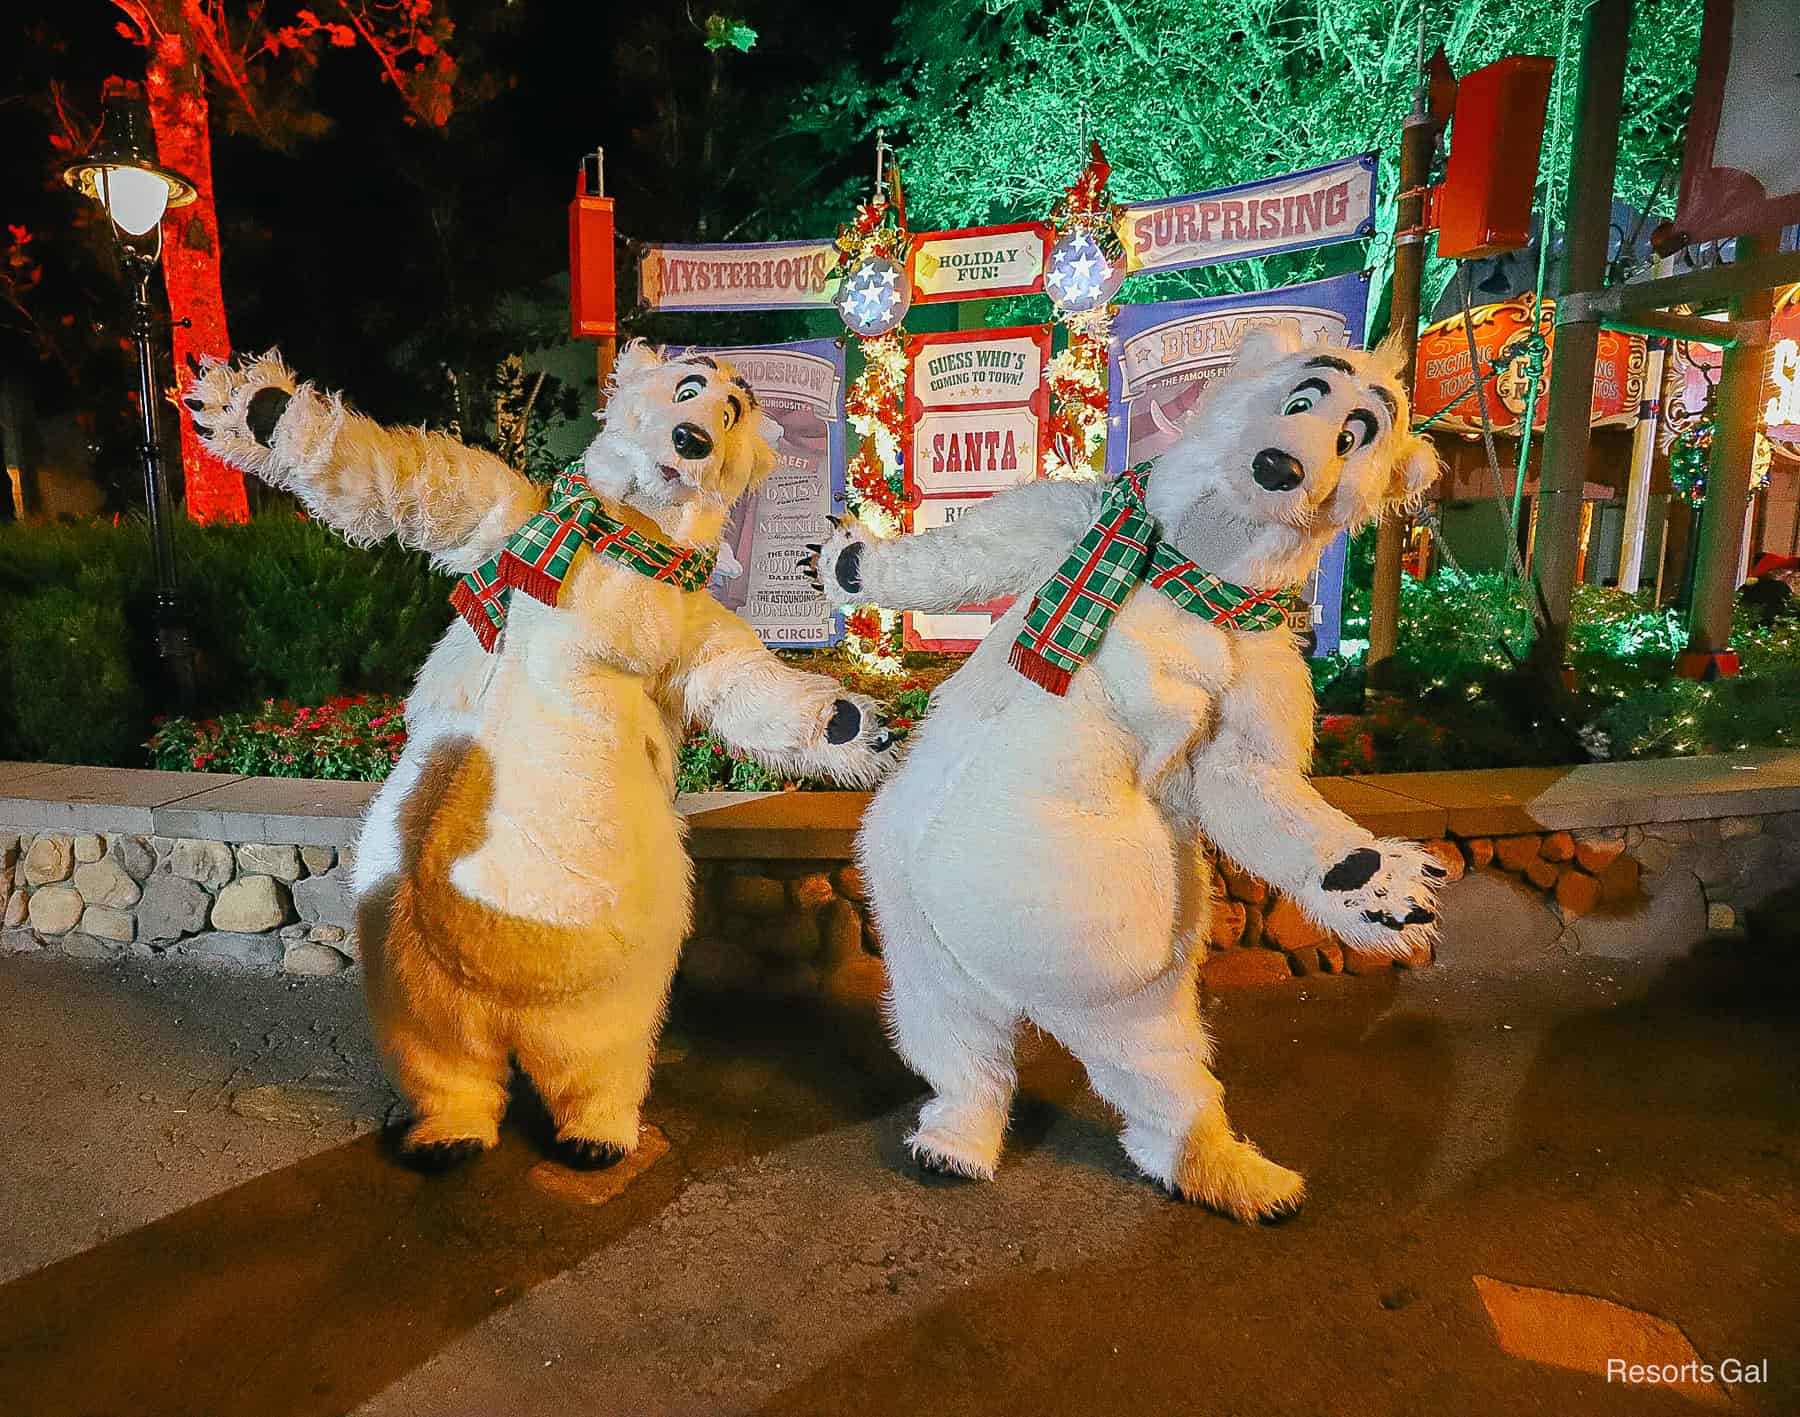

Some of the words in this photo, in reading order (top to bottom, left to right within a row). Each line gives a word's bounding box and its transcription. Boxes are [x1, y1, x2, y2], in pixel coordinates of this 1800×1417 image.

[1134, 181, 1349, 255] SURPRISING
[939, 249, 1018, 268] HOLIDAY
[658, 252, 826, 297] MYSTERIOUS
[958, 266, 999, 281] FUN!
[928, 351, 973, 376] GUESS
[976, 350, 1026, 373] WHO'S
[1426, 343, 1493, 380] EXCITNG
[930, 373, 969, 391] COMING
[972, 371, 985, 383] TO
[988, 371, 1024, 386] TOWN!
[1161, 376, 1178, 387] THE
[1179, 369, 1216, 383] FAMOUS
[933, 430, 1017, 473] SANTA
[766, 483, 825, 501] DAISY
[759, 519, 825, 535] MINNIE
[768, 551, 781, 559] THE
[784, 549, 810, 558] GREAT
[757, 594, 770, 603] THE
[770, 594, 817, 604] ASTOUNDING
[1287, 615, 1306, 628] US
[776, 628, 824, 640] CIRCUS
